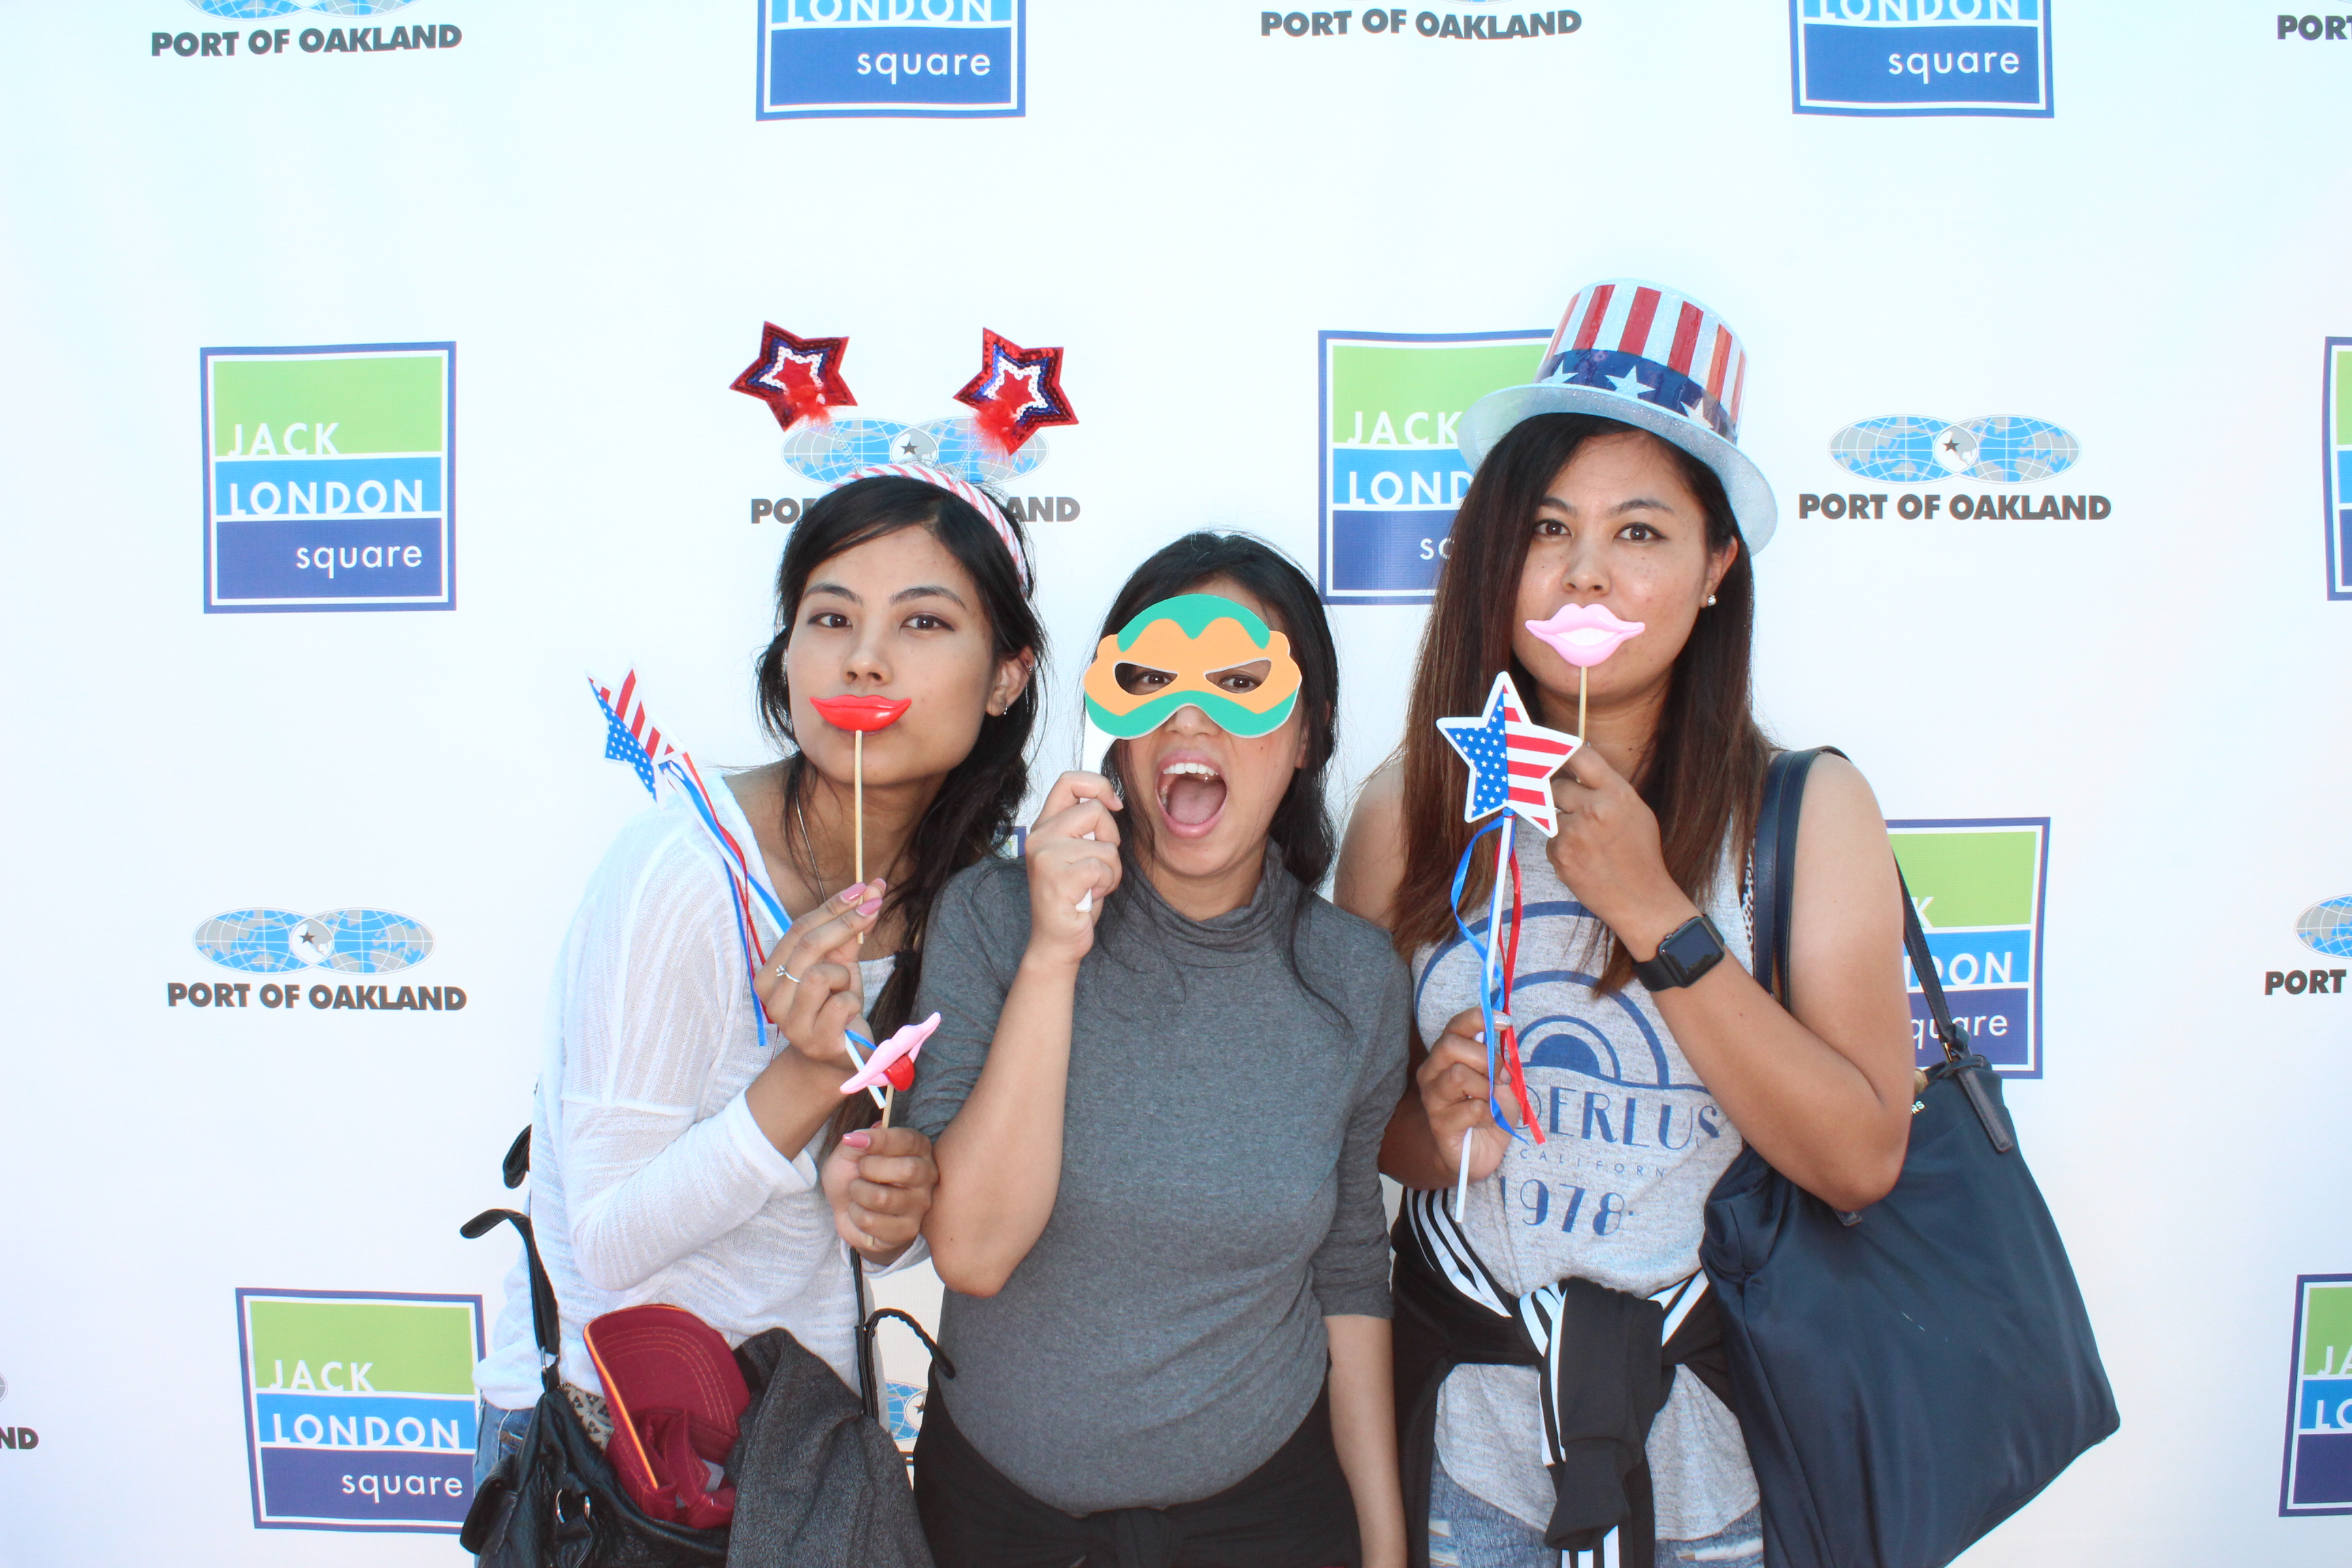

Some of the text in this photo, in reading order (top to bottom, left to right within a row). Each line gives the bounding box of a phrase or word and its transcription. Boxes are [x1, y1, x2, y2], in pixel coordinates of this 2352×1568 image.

[788, 0, 992, 23] LONDON
[1261, 8, 1582, 39] PORT OF OAKLAND
[151, 24, 463, 56] PORT OF OAKLAND
[857, 52, 990, 85] square
[1889, 50, 2020, 84] square
[228, 423, 340, 457] JACK
[1347, 410, 1463, 444] JACK
[230, 478, 423, 516] LONDON
[1350, 471, 1474, 506] LOND
[1799, 493, 2112, 521] PORT OF OAKLAND
[296, 544, 423, 578] square
[167, 982, 468, 1011] PORT OF OAKLAND
[2264, 969, 2347, 995] PORT
[1911, 1015, 2008, 1049] quare
[1520, 1148, 1665, 1177] CALIFORN
[269, 1360, 377, 1392] JACK
[272, 1413, 460, 1449] LONDON
[342, 1471, 463, 1503] square
